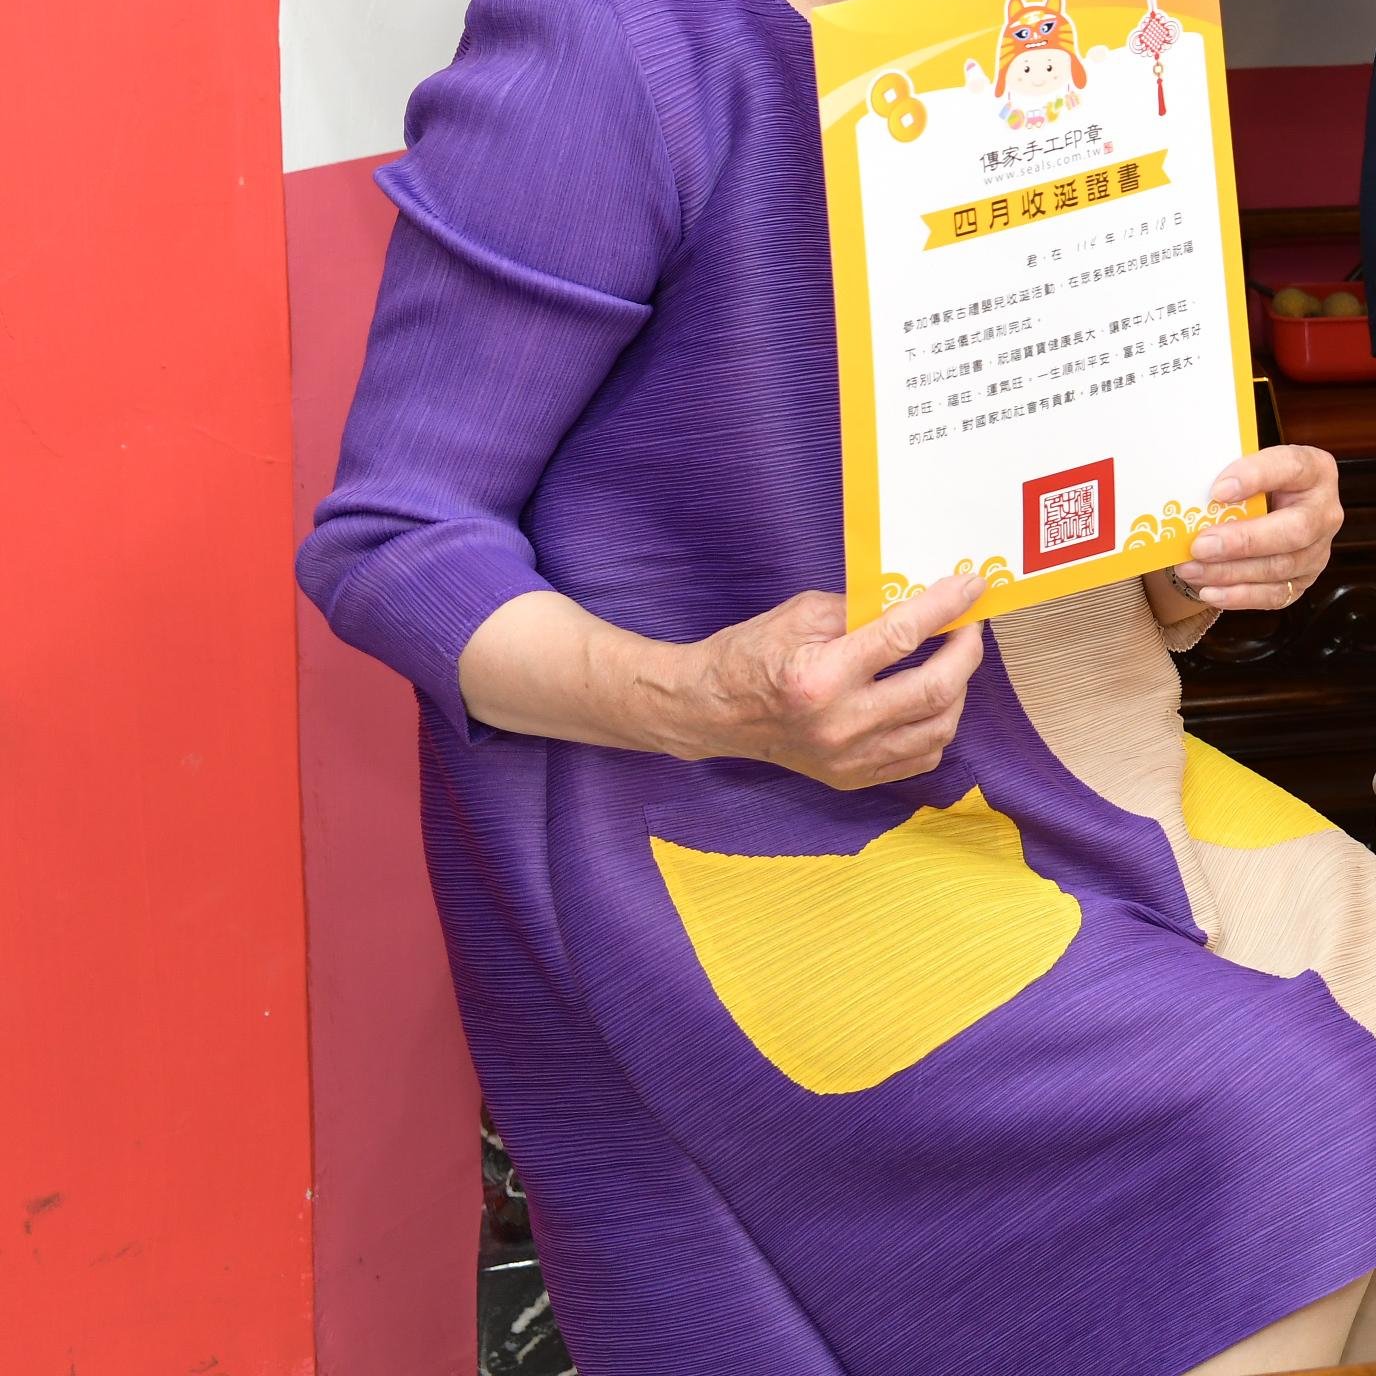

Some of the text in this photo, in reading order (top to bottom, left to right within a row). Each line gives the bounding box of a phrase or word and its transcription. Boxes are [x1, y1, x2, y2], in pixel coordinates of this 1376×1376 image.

[979, 124, 1103, 174] 傳家手工印章
[984, 148, 1102, 185] www.seals.com.tw
[953, 162, 1141, 237] 四月收涎證書
